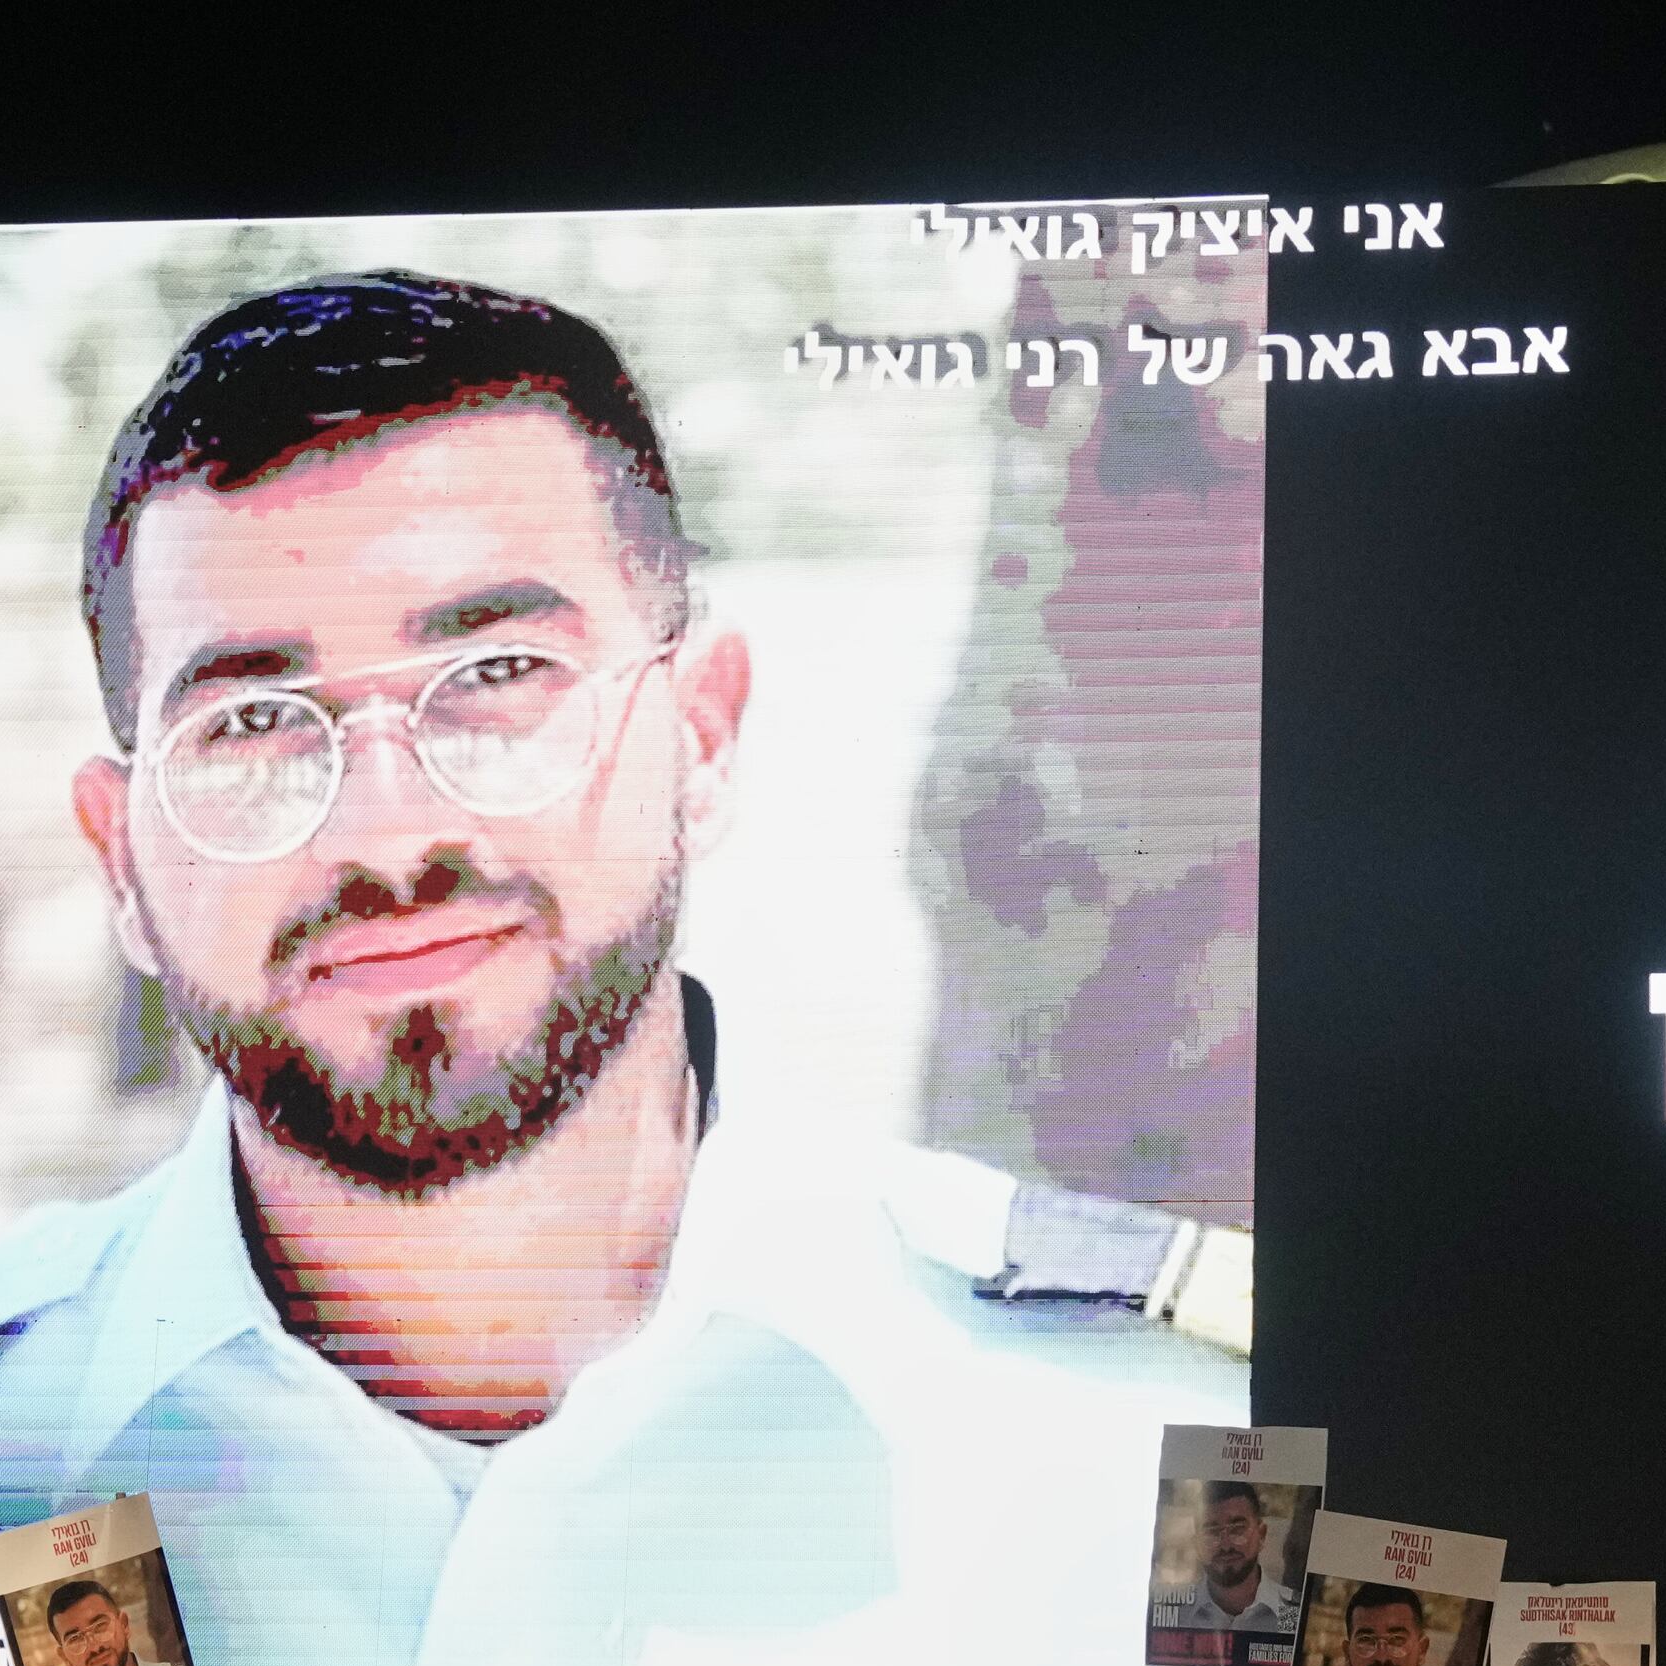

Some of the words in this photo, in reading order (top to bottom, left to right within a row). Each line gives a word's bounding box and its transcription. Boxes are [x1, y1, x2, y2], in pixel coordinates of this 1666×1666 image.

[911, 204, 1101, 261] גואילי
[1132, 206, 1314, 274] איציק
[1344, 202, 1444, 252] אני
[783, 331, 975, 392] גואילי
[1005, 336, 1100, 389] רני
[1127, 326, 1226, 385] של
[1258, 330, 1389, 383] גאה
[1422, 325, 1570, 377] אבא
